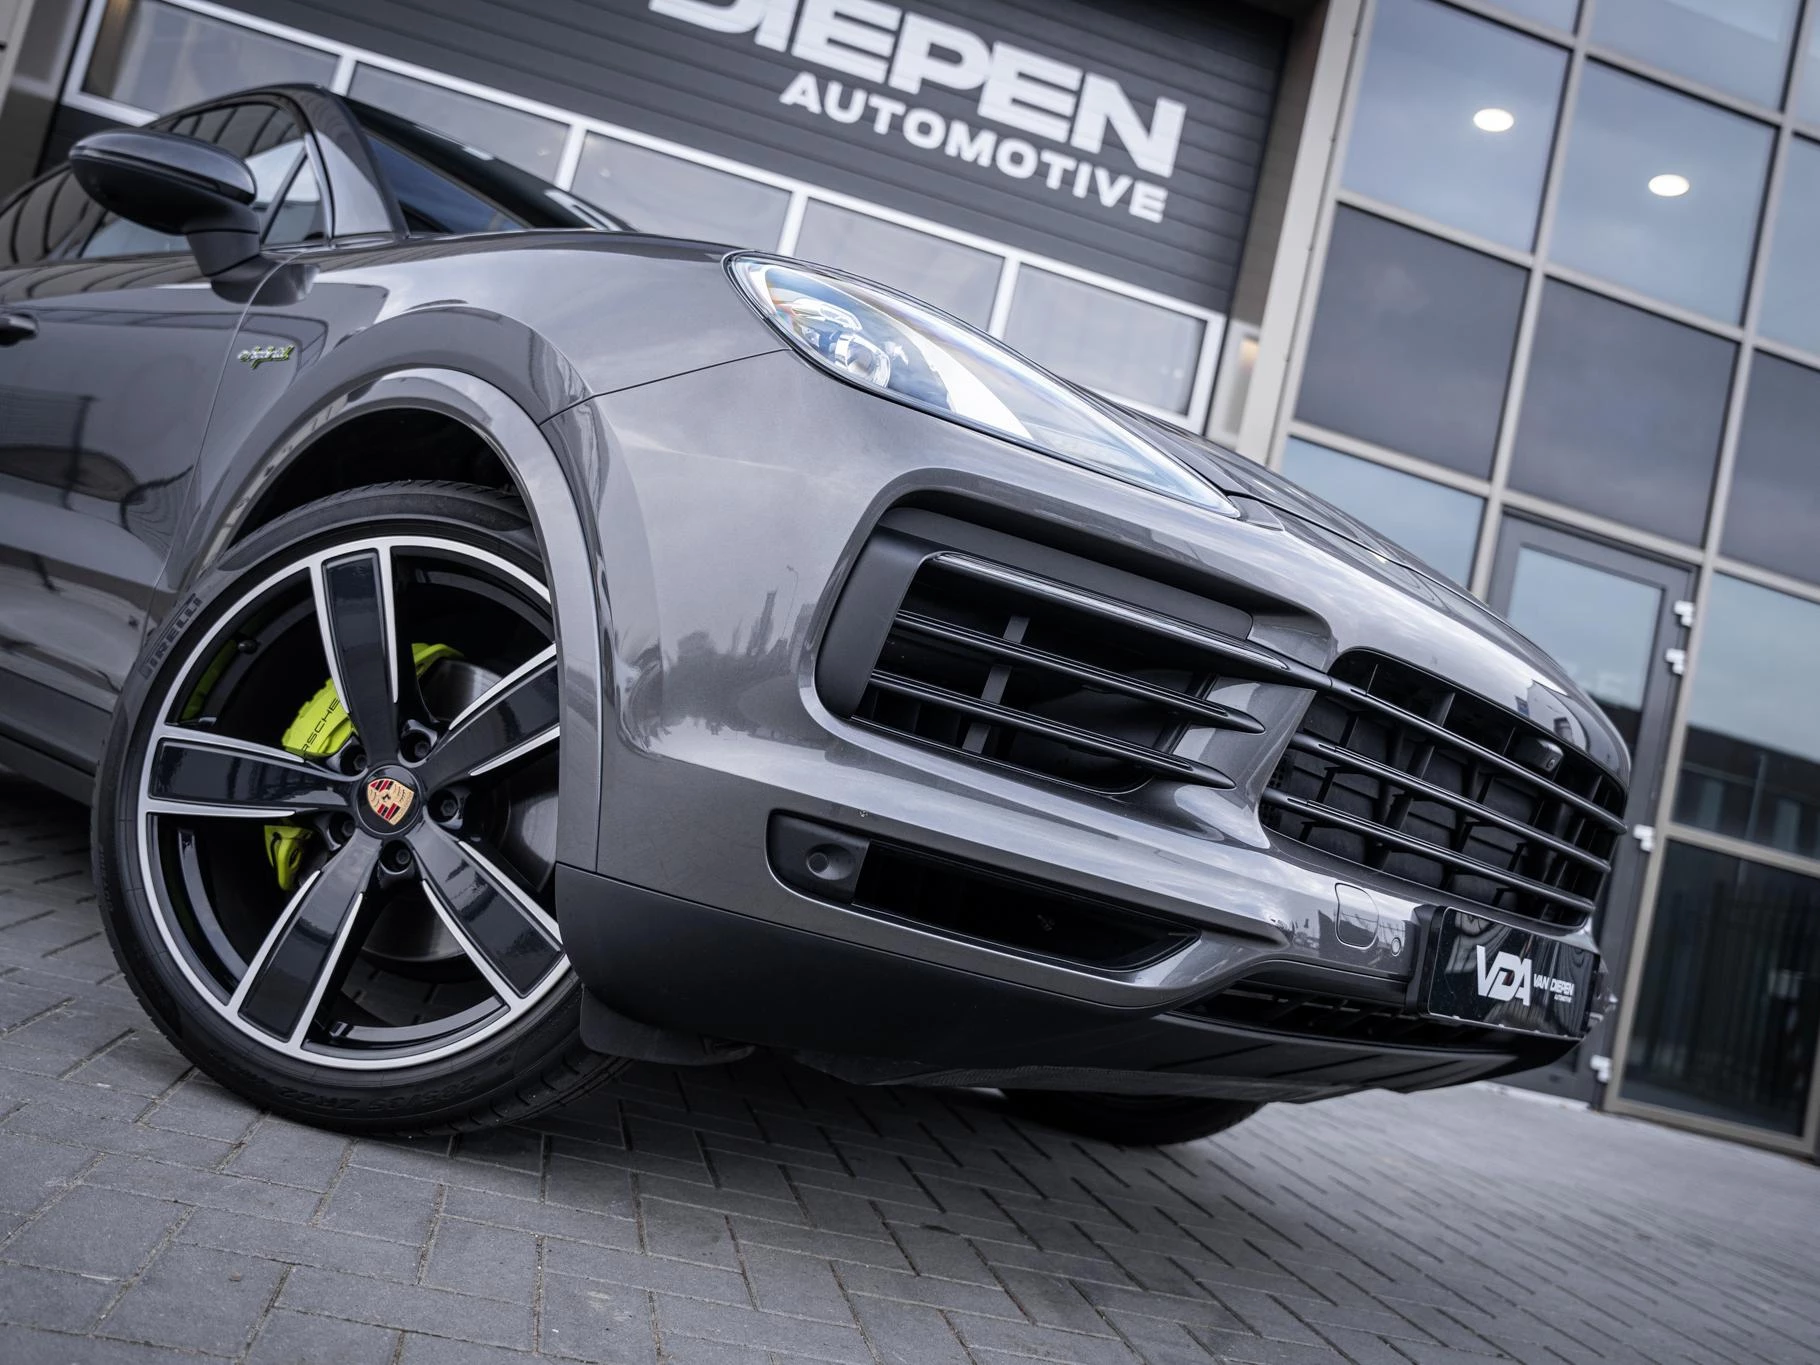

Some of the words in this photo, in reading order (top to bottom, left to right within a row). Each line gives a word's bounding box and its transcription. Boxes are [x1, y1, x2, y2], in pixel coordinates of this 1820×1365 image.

[780, 72, 1169, 224] AUTOMOTIVE
[1476, 945, 1532, 1006] VDA
[1533, 973, 1551, 990] VAN
